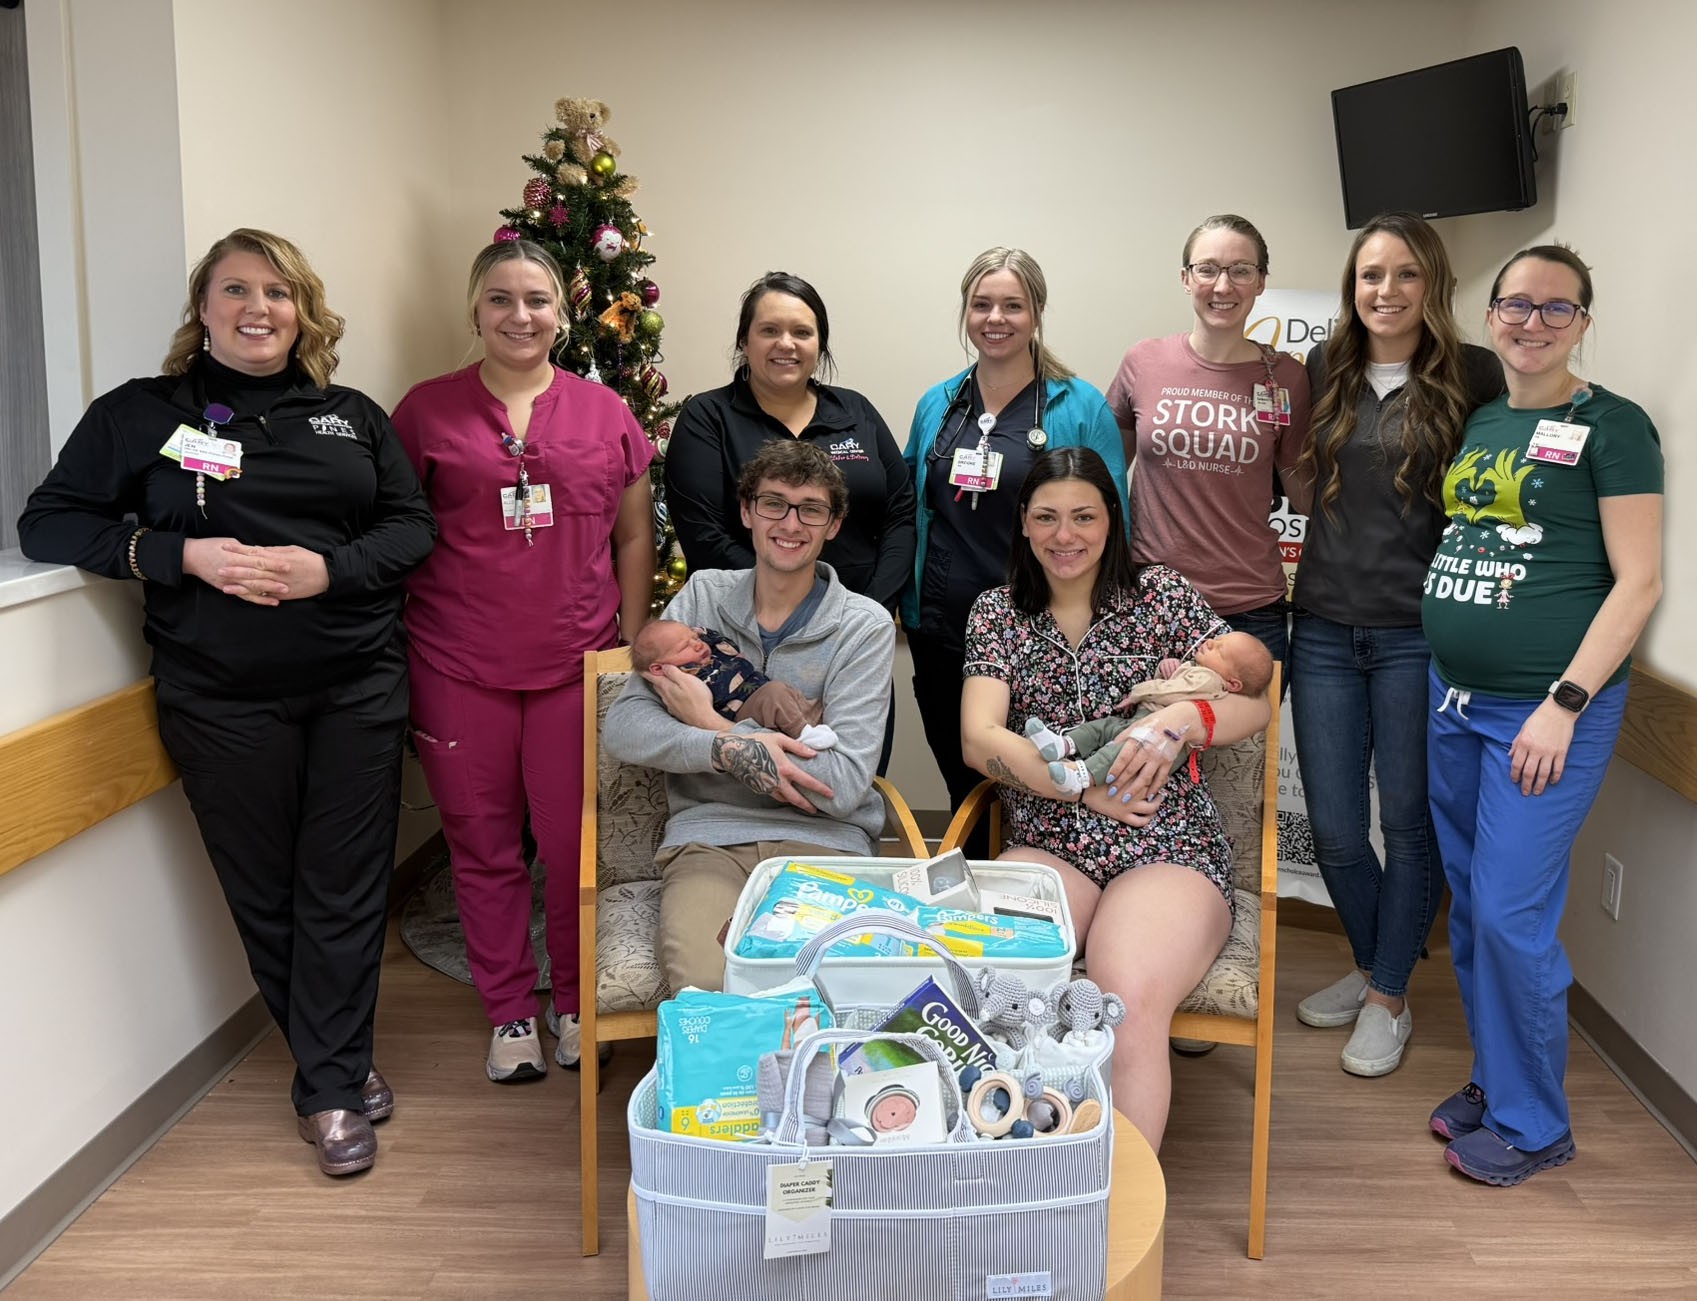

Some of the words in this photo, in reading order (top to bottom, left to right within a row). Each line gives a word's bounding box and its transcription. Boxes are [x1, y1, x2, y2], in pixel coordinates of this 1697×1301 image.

[1286, 318, 1340, 343] Del
[1160, 387, 1190, 397] PROUD
[1191, 388, 1230, 401] MEMBER
[1230, 393, 1242, 402] OF
[1152, 399, 1261, 436] STORK
[1151, 428, 1260, 464] SQUAD
[1545, 450, 1561, 460] RN
[202, 462, 220, 472] RN
[1176, 460, 1196, 470] L&D
[1198, 461, 1231, 475] NURSE
[967, 477, 980, 486] RN
[1475, 560, 1527, 581] WHO
[1435, 575, 1495, 605] DUE
[796, 880, 870, 912] Pampe
[936, 909, 998, 925] Pampers
[681, 1024, 707, 1034] DIAPERS
[687, 1033, 700, 1045] 16
[680, 1116, 691, 1132] 6
[779, 1181, 800, 1189] DIAPER
[800, 1179, 820, 1187] CADDY
[782, 1187, 816, 1195] ORGANIZER
[992, 1286, 1012, 1294] LILY
[1018, 1283, 1047, 1293] MILES
